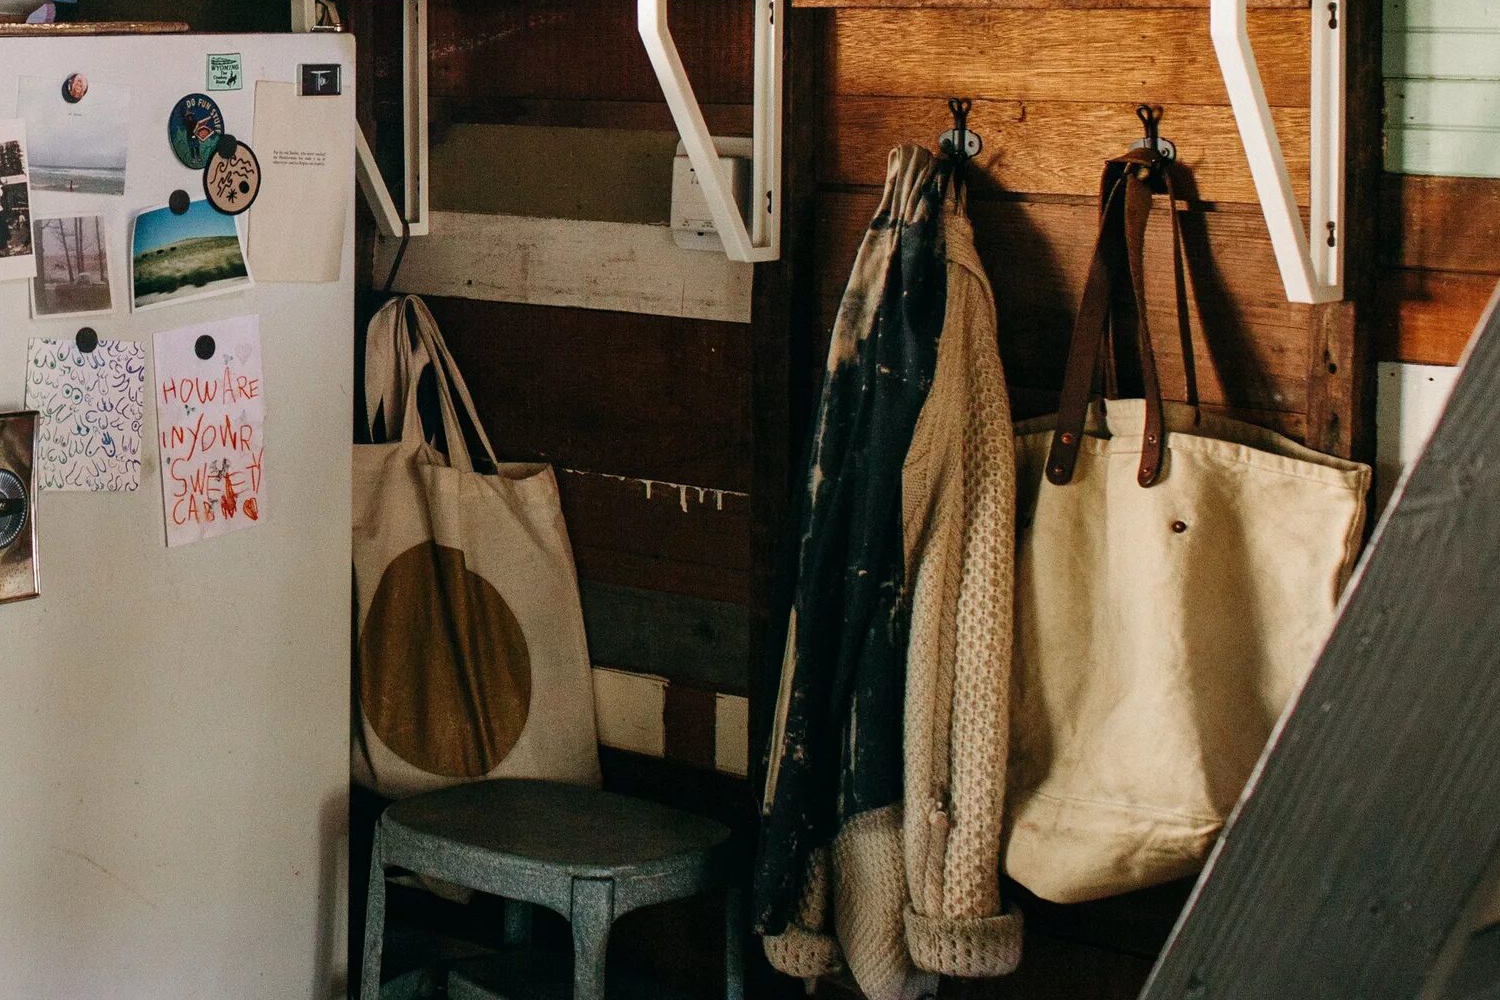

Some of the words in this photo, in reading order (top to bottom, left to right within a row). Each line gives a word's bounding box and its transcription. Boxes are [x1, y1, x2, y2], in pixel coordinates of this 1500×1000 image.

[211, 63, 239, 71] WYOMING
[186, 98, 196, 108] DO
[197, 98, 212, 111] FUN
[210, 108, 222, 134] STUFF
[162, 377, 218, 405] HOW
[222, 366, 260, 405] ARE
[162, 425, 184, 449] IN
